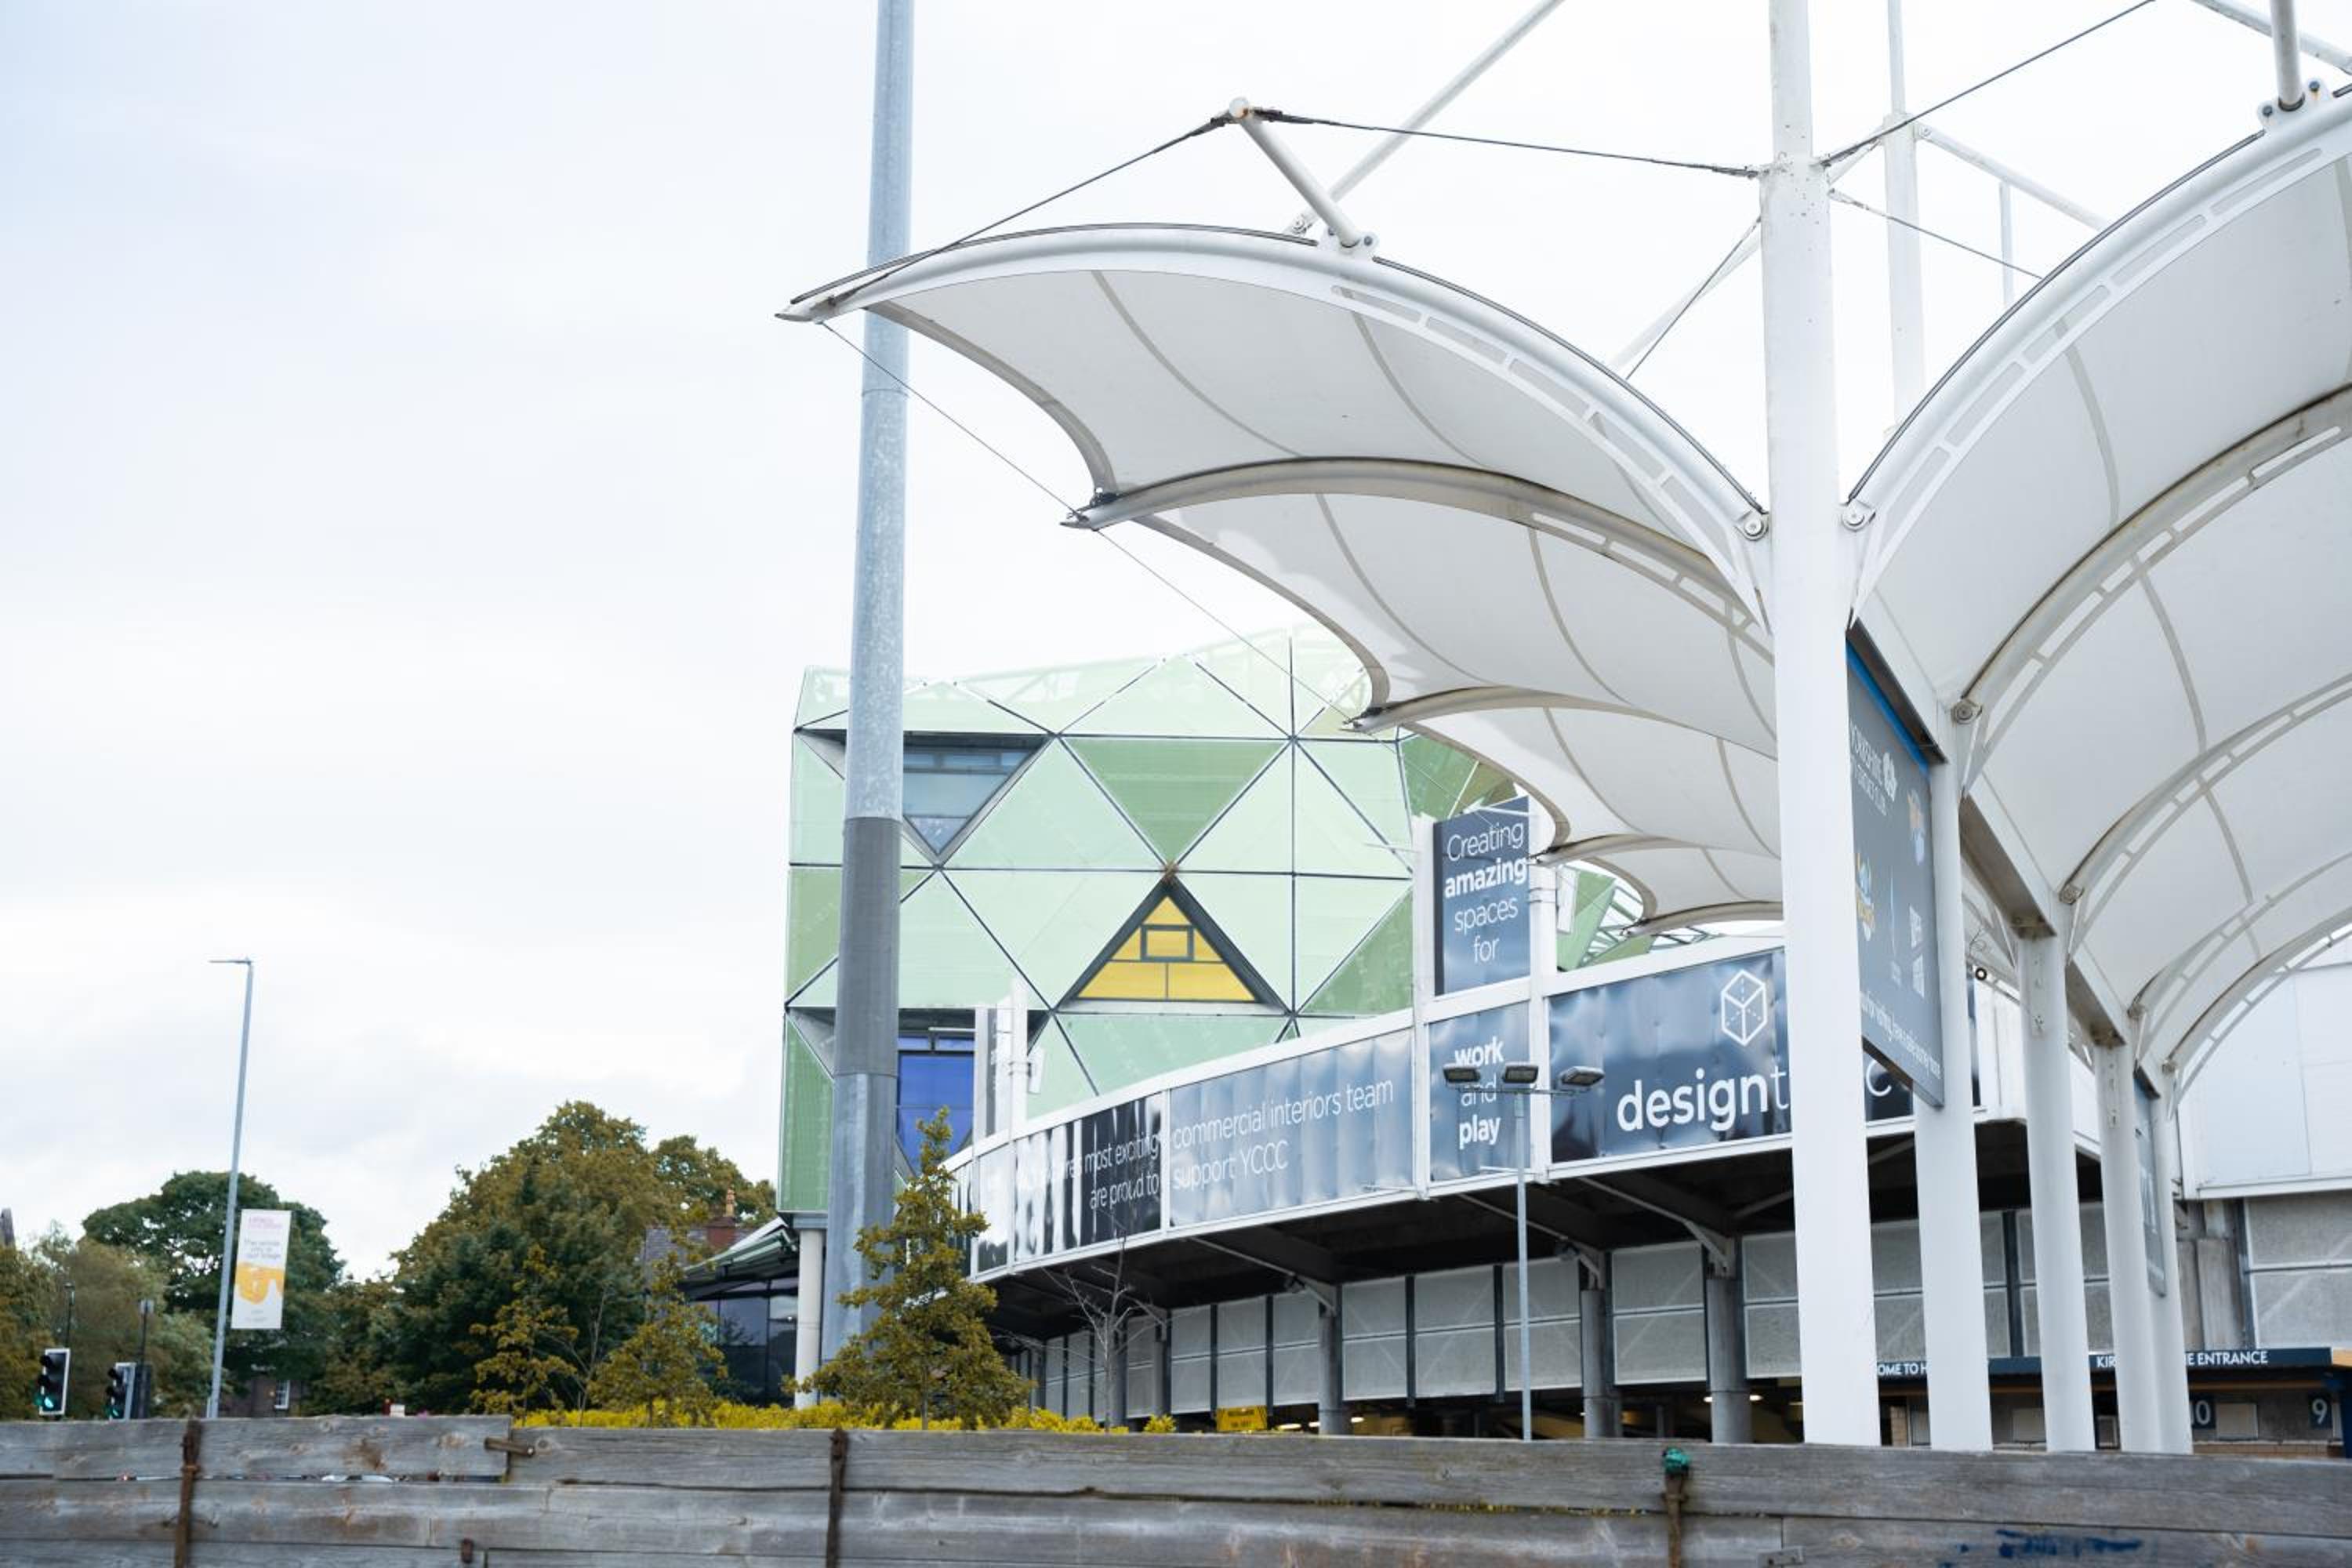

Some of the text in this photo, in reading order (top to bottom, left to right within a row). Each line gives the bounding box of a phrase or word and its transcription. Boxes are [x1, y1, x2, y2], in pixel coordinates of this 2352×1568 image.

[1447, 822, 1524, 862] Creating
[1444, 857, 1528, 898] amazing
[1454, 897, 1519, 935] spaces
[1473, 935, 1501, 964] for
[1454, 1036, 1504, 1066] work
[1461, 1073, 1497, 1107] and
[1085, 1142, 1112, 1174] most
[1116, 1131, 1160, 1166] exciting
[1172, 1102, 1266, 1149] commercial
[1270, 1091, 1341, 1130] interiors
[1345, 1080, 1394, 1113] team
[1459, 1114, 1501, 1150] play
[1089, 1140, 1290, 1210] are proud to support YCCC
[1904, 1363, 1919, 1374] TO
[2197, 1351, 2269, 1367] ENTRANCE
[2312, 1398, 2328, 1425] 9
